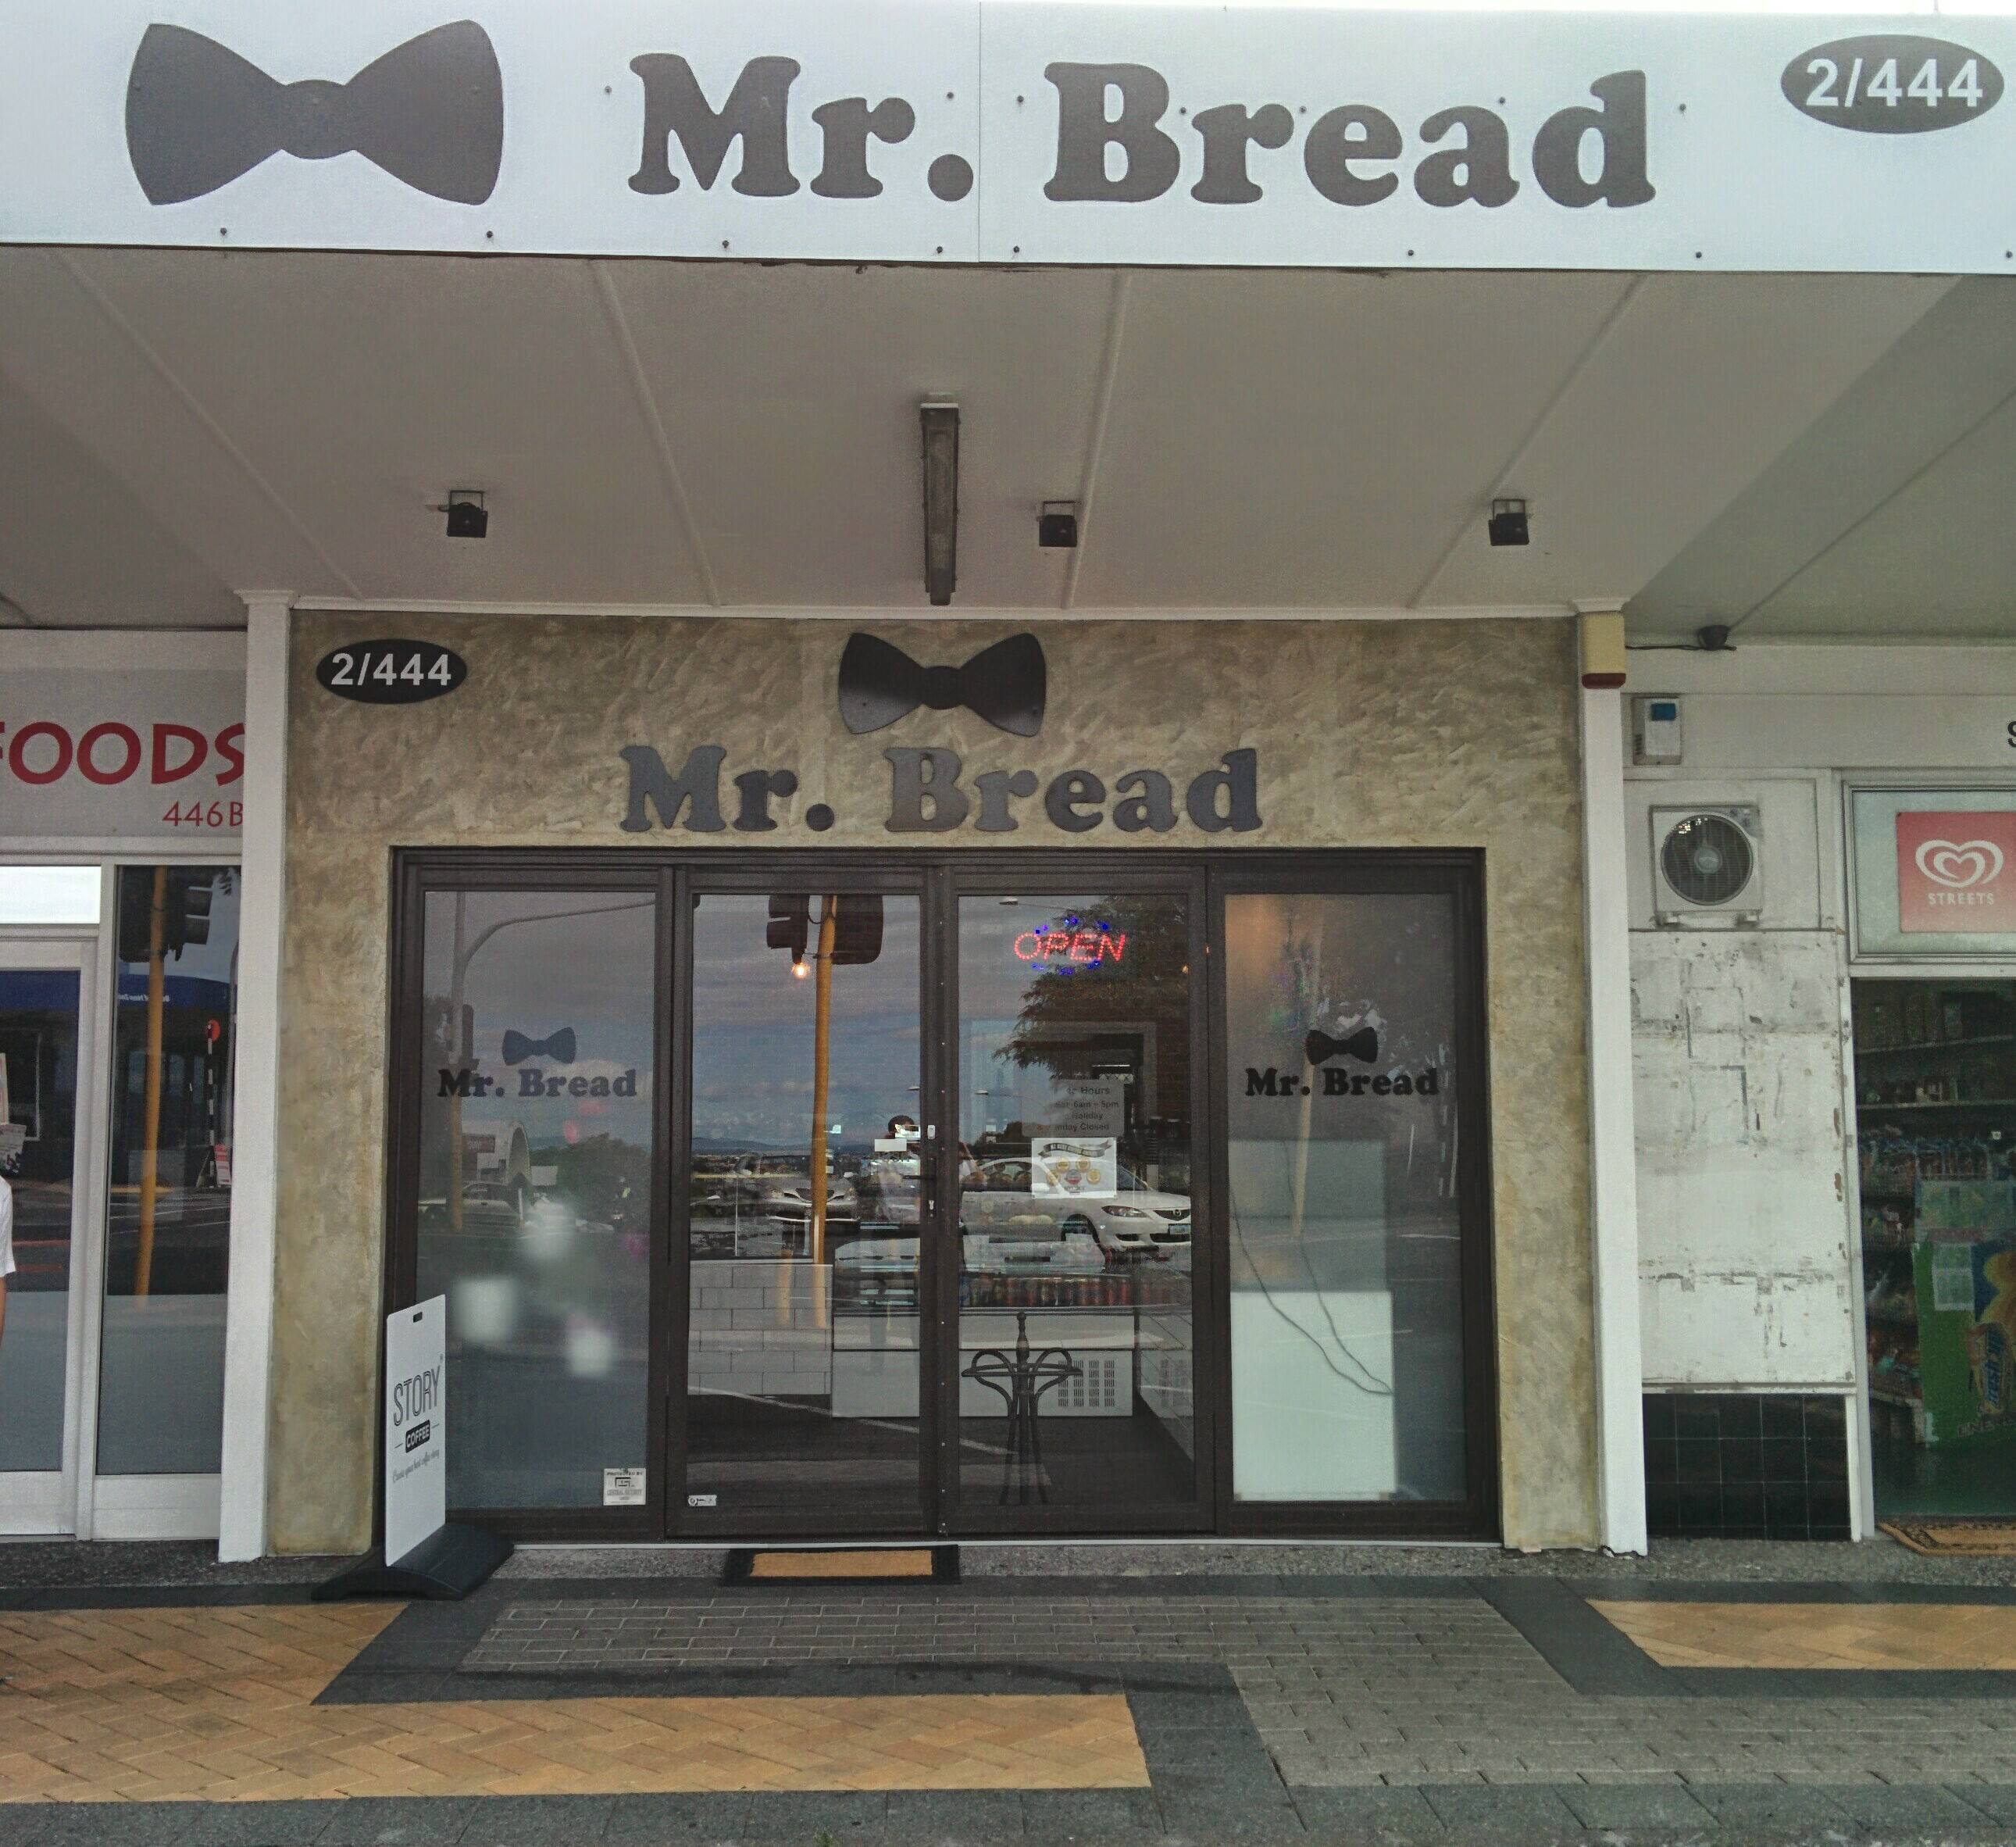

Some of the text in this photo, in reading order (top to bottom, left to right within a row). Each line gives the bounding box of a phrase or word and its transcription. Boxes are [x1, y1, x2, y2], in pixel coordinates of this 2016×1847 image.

[1805, 57, 1984, 108] 2/444
[627, 52, 1657, 208] Mr. Bread
[330, 652, 452, 687] 2/444
[0, 721, 244, 787] OODS
[619, 745, 1264, 833] Mr. Bread
[162, 801, 244, 827] 446B
[1927, 892, 1996, 906] STREETS
[1013, 932, 1126, 962] OPEN
[437, 1068, 637, 1098] Mr. Bread
[1080, 1086, 1111, 1095] Hours
[1245, 1067, 1441, 1097] Mr. Bread
[1101, 1100, 1119, 1109] 5pm
[393, 1365, 441, 1427] STORY
[406, 1423, 430, 1448] COFFEE
